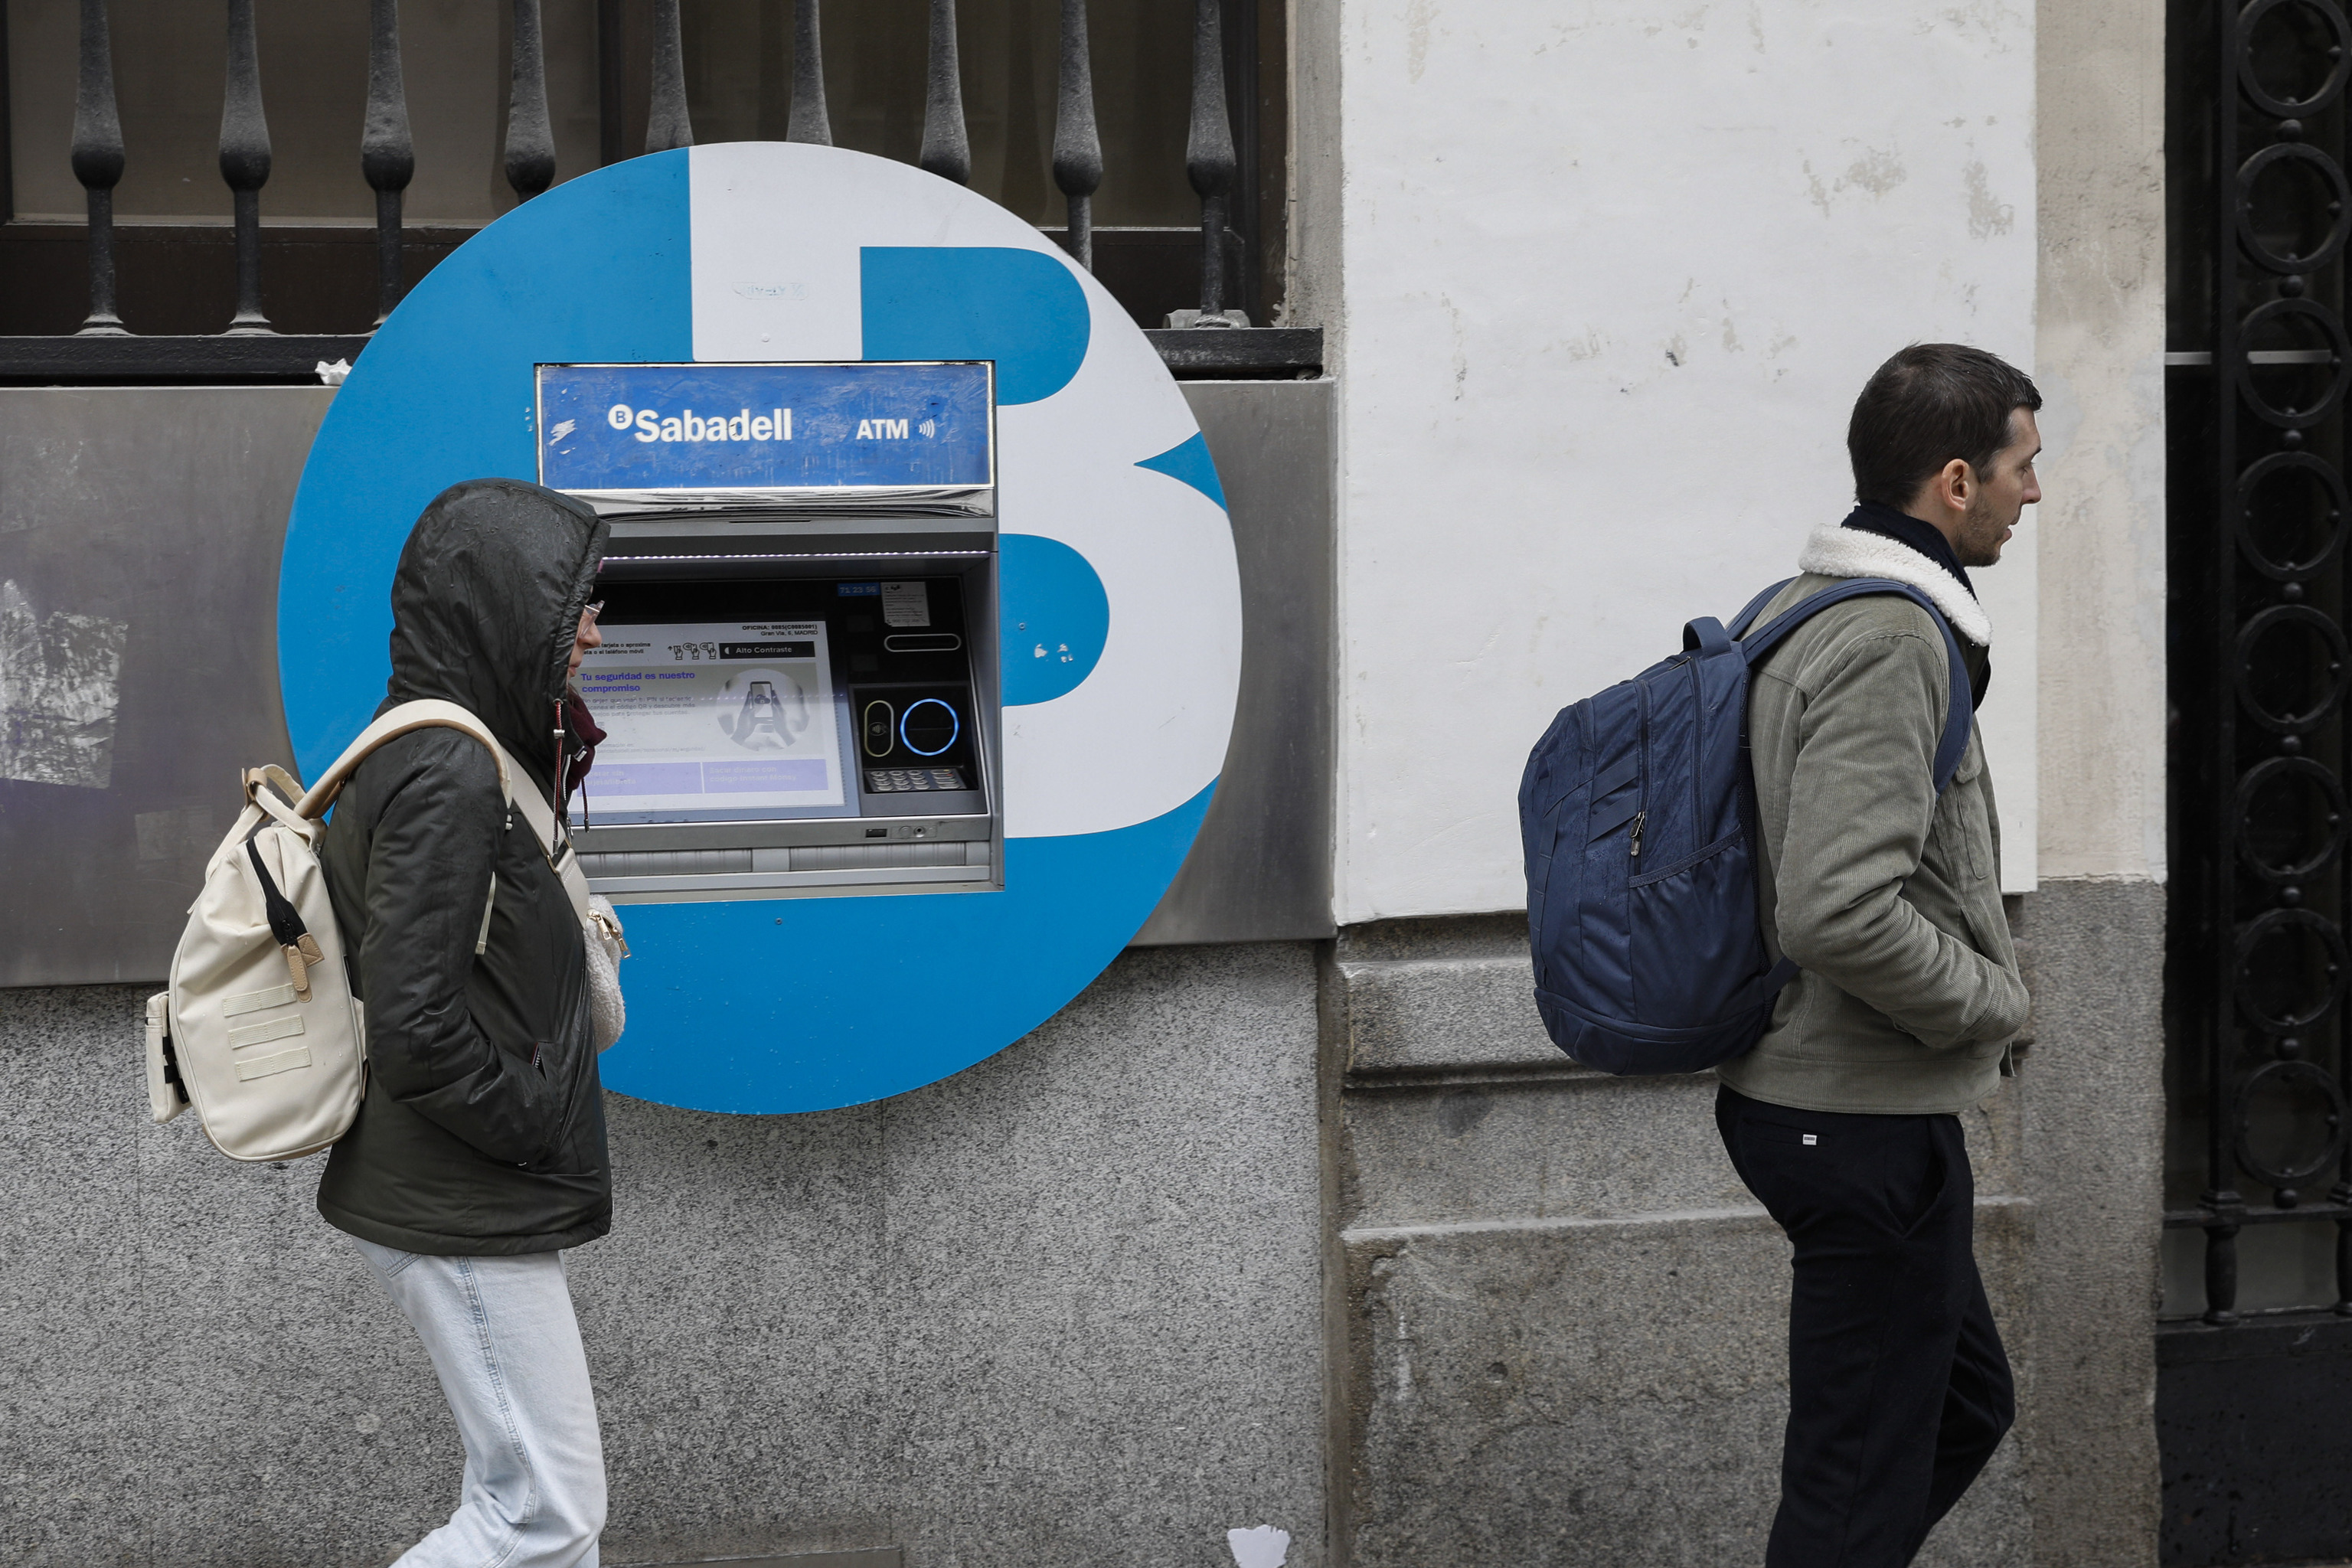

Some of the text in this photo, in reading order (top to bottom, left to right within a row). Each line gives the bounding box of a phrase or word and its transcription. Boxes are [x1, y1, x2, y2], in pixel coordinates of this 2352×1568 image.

[635, 408, 792, 443] Sabadell
[855, 418, 909, 440] ATM
[595, 672, 642, 682] seguridad
[659, 671, 695, 680] nuestro
[582, 684, 641, 694] compromiso
